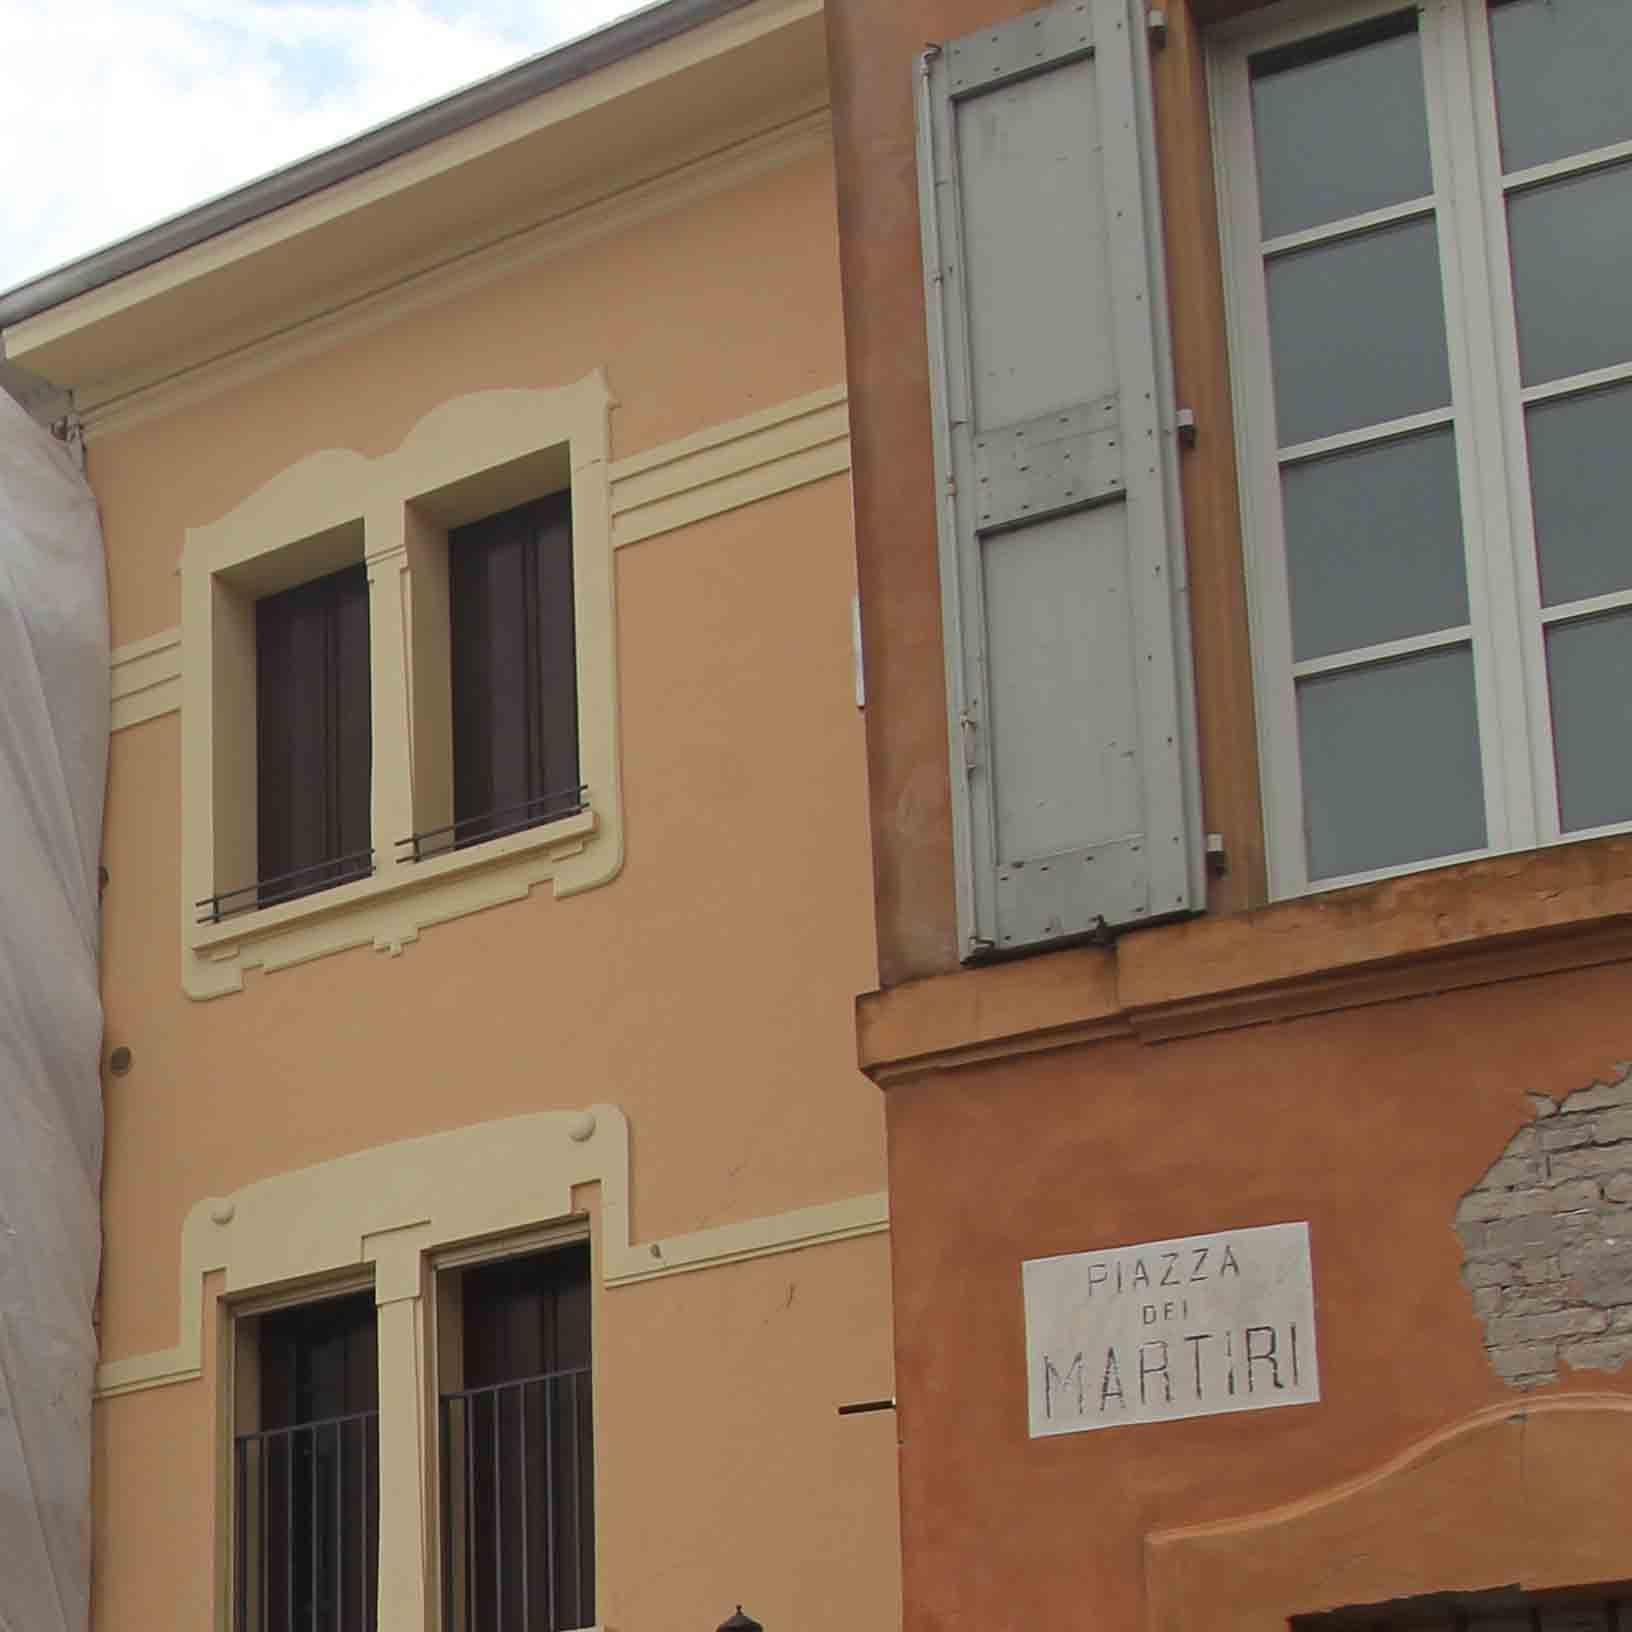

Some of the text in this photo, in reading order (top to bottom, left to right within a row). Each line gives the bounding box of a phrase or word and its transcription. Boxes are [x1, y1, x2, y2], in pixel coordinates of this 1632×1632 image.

[1087, 1244, 1242, 1297] PIAZZA
[1142, 1299, 1188, 1326] DEI
[1042, 1321, 1300, 1419] MARTIRI
